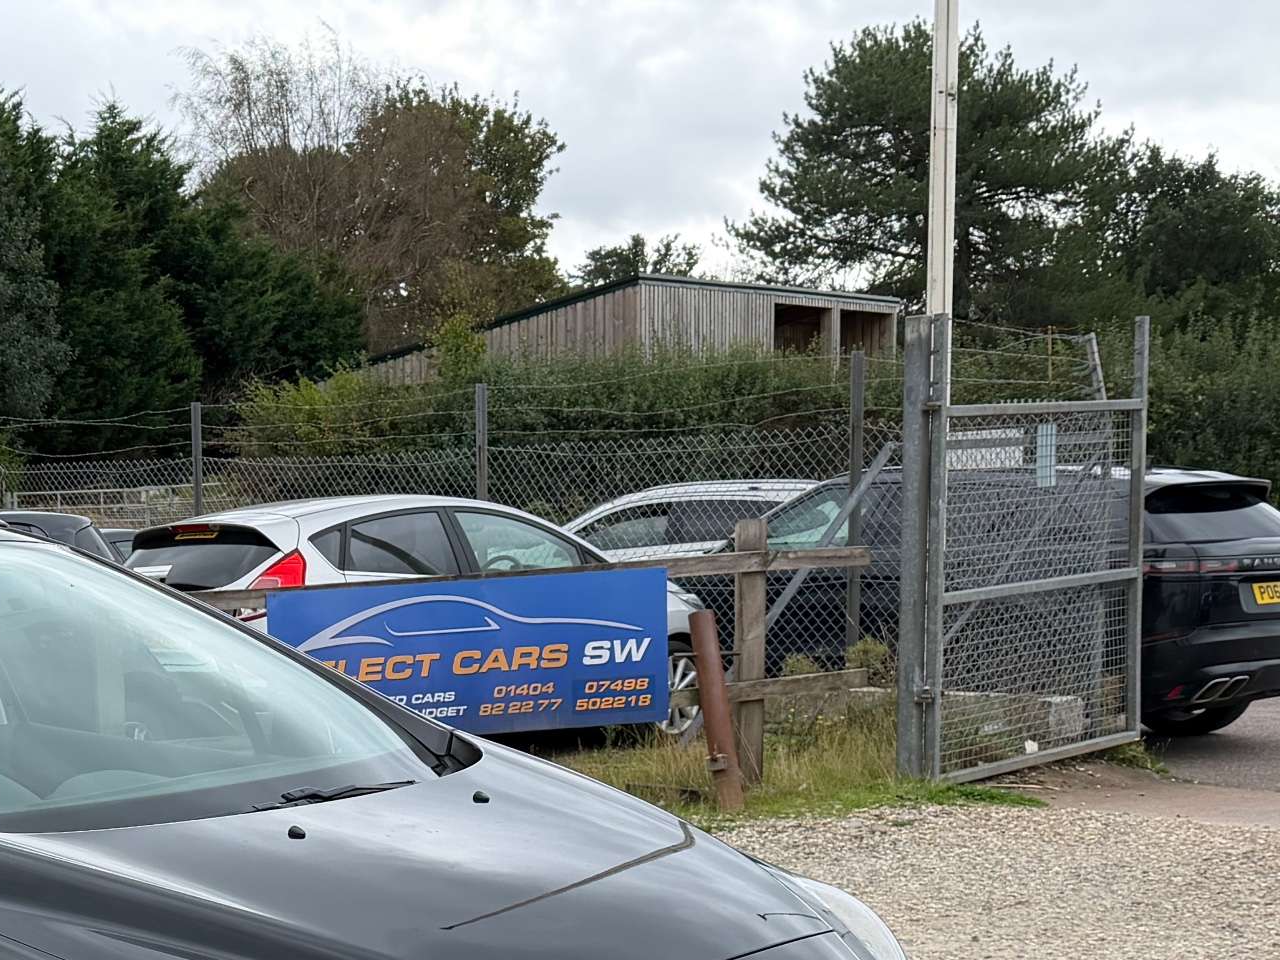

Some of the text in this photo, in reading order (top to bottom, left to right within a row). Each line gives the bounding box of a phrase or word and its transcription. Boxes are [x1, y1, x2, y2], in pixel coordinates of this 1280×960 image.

[452, 643, 569, 676] CARS
[582, 637, 652, 665] SW
[493, 682, 556, 698] 01404
[584, 677, 650, 694] 07498
[411, 691, 455, 704] CARS
[575, 694, 652, 711] 502218
